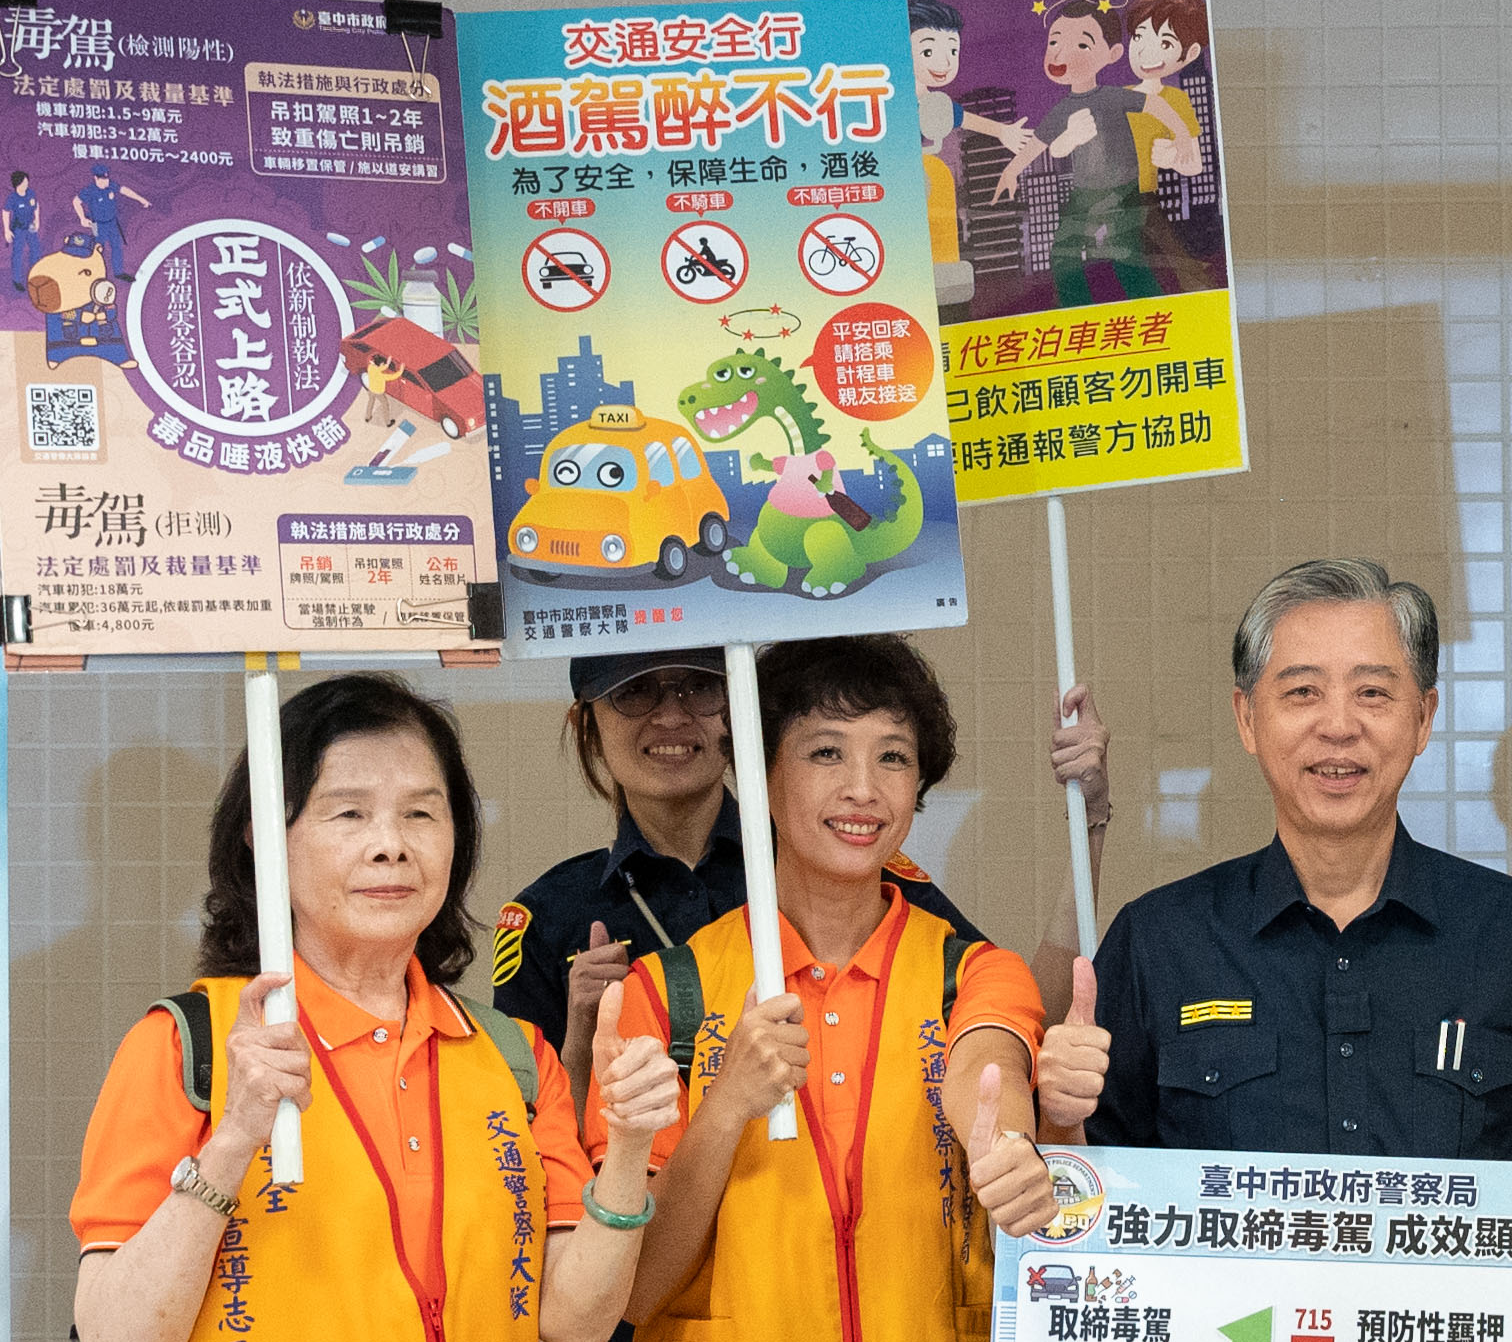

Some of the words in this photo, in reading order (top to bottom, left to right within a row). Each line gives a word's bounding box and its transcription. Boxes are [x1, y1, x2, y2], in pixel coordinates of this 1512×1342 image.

[4, 6, 116, 71] 毒駕
[118, 33, 234, 63] (檢測陽性)
[566, 15, 801, 66] 交通安全行
[13, 74, 234, 107] 法定處罰及裁量基準
[271, 101, 423, 129] 吊扣駕照1~2年
[486, 68, 891, 157] 酒駕醉不行
[271, 127, 425, 154] 致重傷亡則吊銷
[675, 193, 725, 211] 不騎車
[794, 185, 878, 204] 不騎自行車
[534, 201, 588, 217] 不開車
[164, 258, 199, 388] 毒駕零容忍
[210, 236, 279, 422] 正式上路
[287, 262, 321, 392] 依新制執法
[832, 319, 911, 340] 平安回家
[959, 311, 1173, 370] 代客泊車業者
[835, 342, 893, 363] 請搭乘
[836, 364, 896, 383] 計程車
[838, 384, 917, 406] 親友接送
[598, 413, 629, 423] TAXI
[151, 412, 346, 470] 毒品唾液快篩
[35, 482, 148, 547] 毒駕
[155, 510, 232, 537] (拒測)
[291, 521, 460, 541] 執法措施與行政處分
[37, 555, 262, 577] 法定處罰及裁量基準
[300, 556, 333, 571] 吊銷
[355, 558, 403, 569] 吊扣駕照
[427, 557, 458, 571] 公布
[290, 573, 344, 584] 牌照/駕照
[368, 571, 393, 584] 2年
[420, 574, 467, 586] 姓名照片
[299, 604, 375, 615] 當場禁止駕駛
[522, 604, 627, 625] 臺中市政府警察局
[313, 616, 364, 627] 強制作為
[524, 619, 628, 641] 交通警察大隊
[698, 1012, 727, 1097] 交通
[1200, 1167, 1478, 1208] 臺中市政府警察局
[486, 1111, 535, 1320] 交通警察大隊
[1107, 1204, 1373, 1254] 強力取締毒駕
[1295, 1309, 1332, 1330] 715
